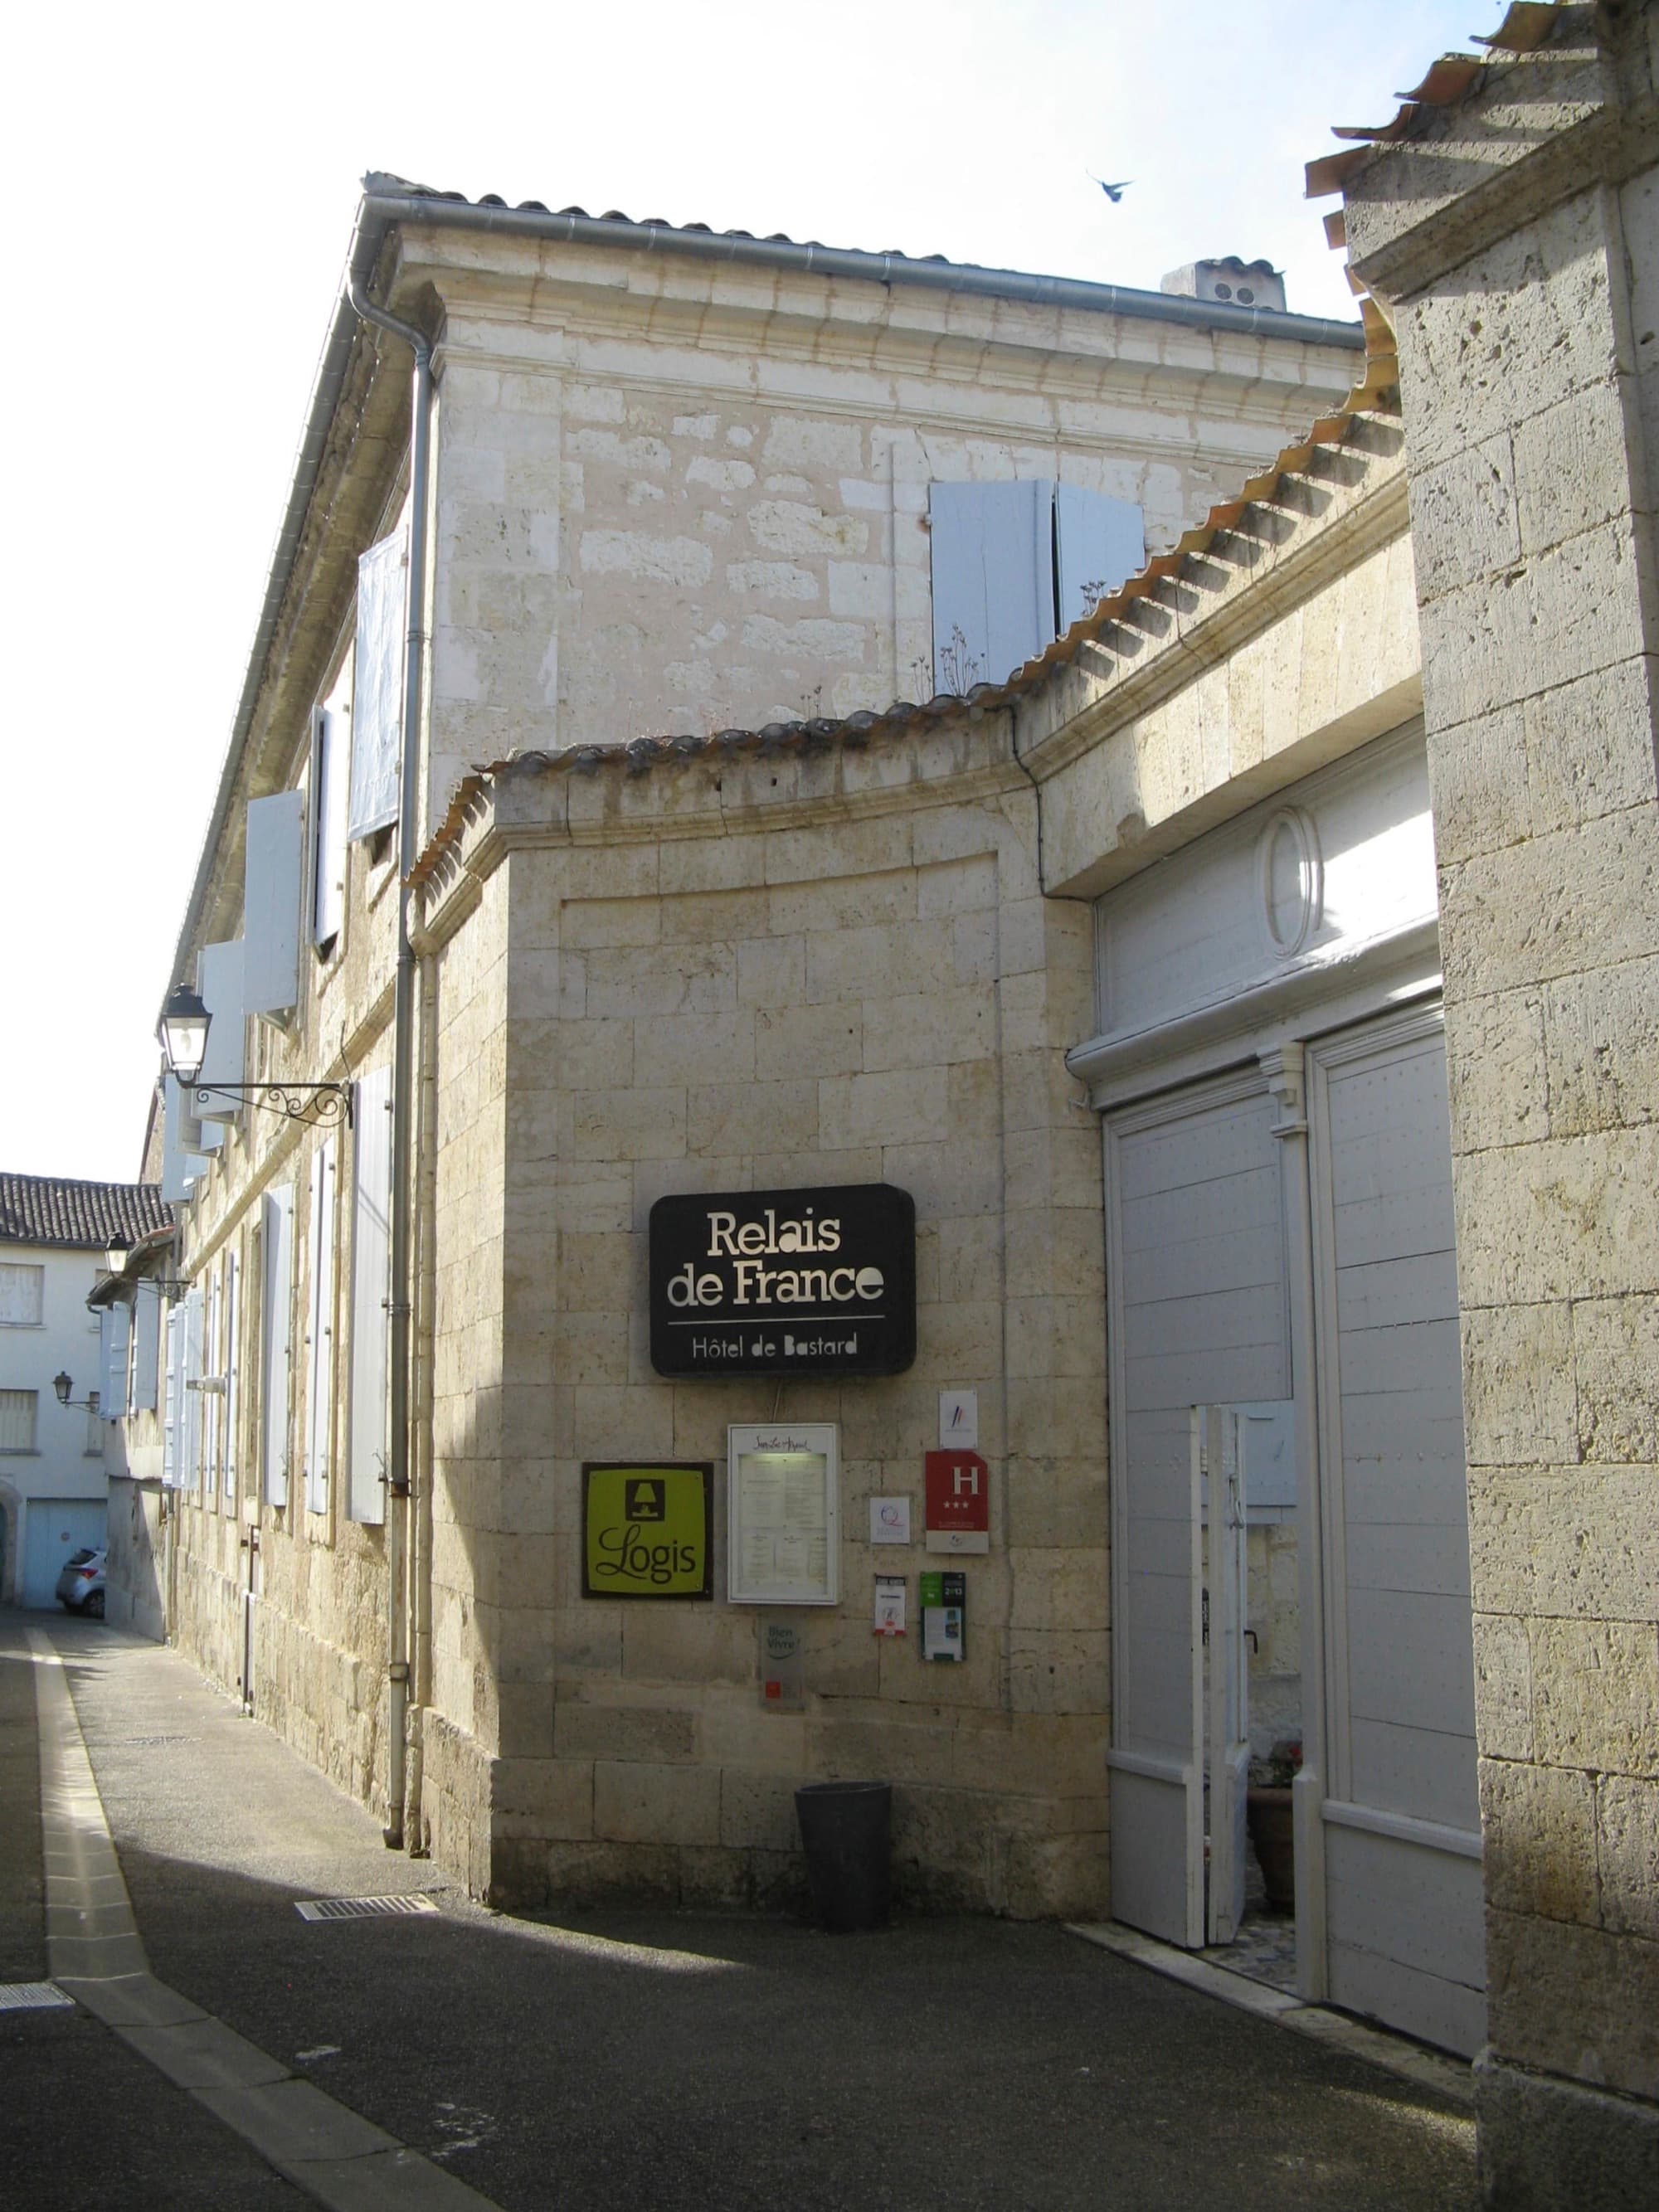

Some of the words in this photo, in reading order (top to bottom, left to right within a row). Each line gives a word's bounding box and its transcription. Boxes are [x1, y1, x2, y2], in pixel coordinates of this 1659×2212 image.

[706, 1208, 841, 1257] Relais
[667, 1263, 723, 1307] de
[732, 1259, 884, 1305] France
[693, 1335, 743, 1359] Hôtel
[752, 1334, 776, 1357] de
[784, 1332, 858, 1356] Bastard
[954, 1466, 978, 1494] H
[596, 1524, 696, 1584] Logis
